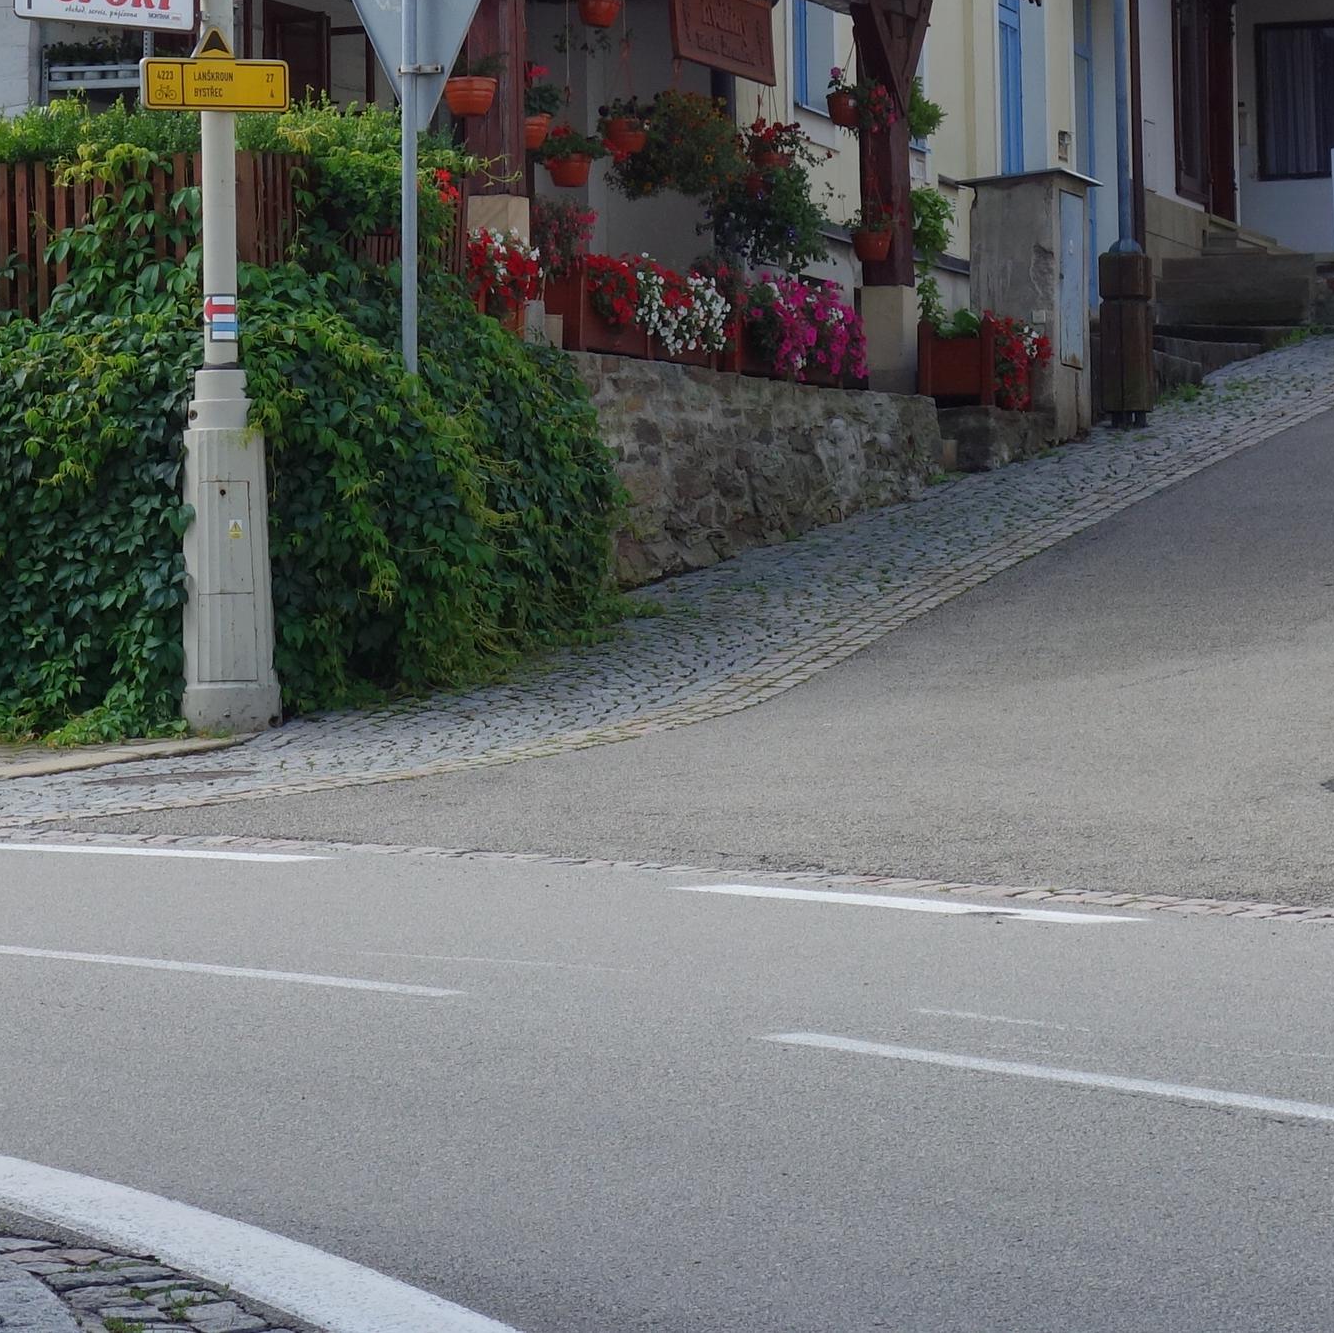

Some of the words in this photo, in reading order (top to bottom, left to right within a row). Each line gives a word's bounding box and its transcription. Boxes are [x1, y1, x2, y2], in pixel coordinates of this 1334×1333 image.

[157, 70, 174, 80] 4223
[193, 69, 234, 82] LANŠKROUN
[266, 73, 274, 83] 27
[194, 86, 223, 98] BYSTŘEC
